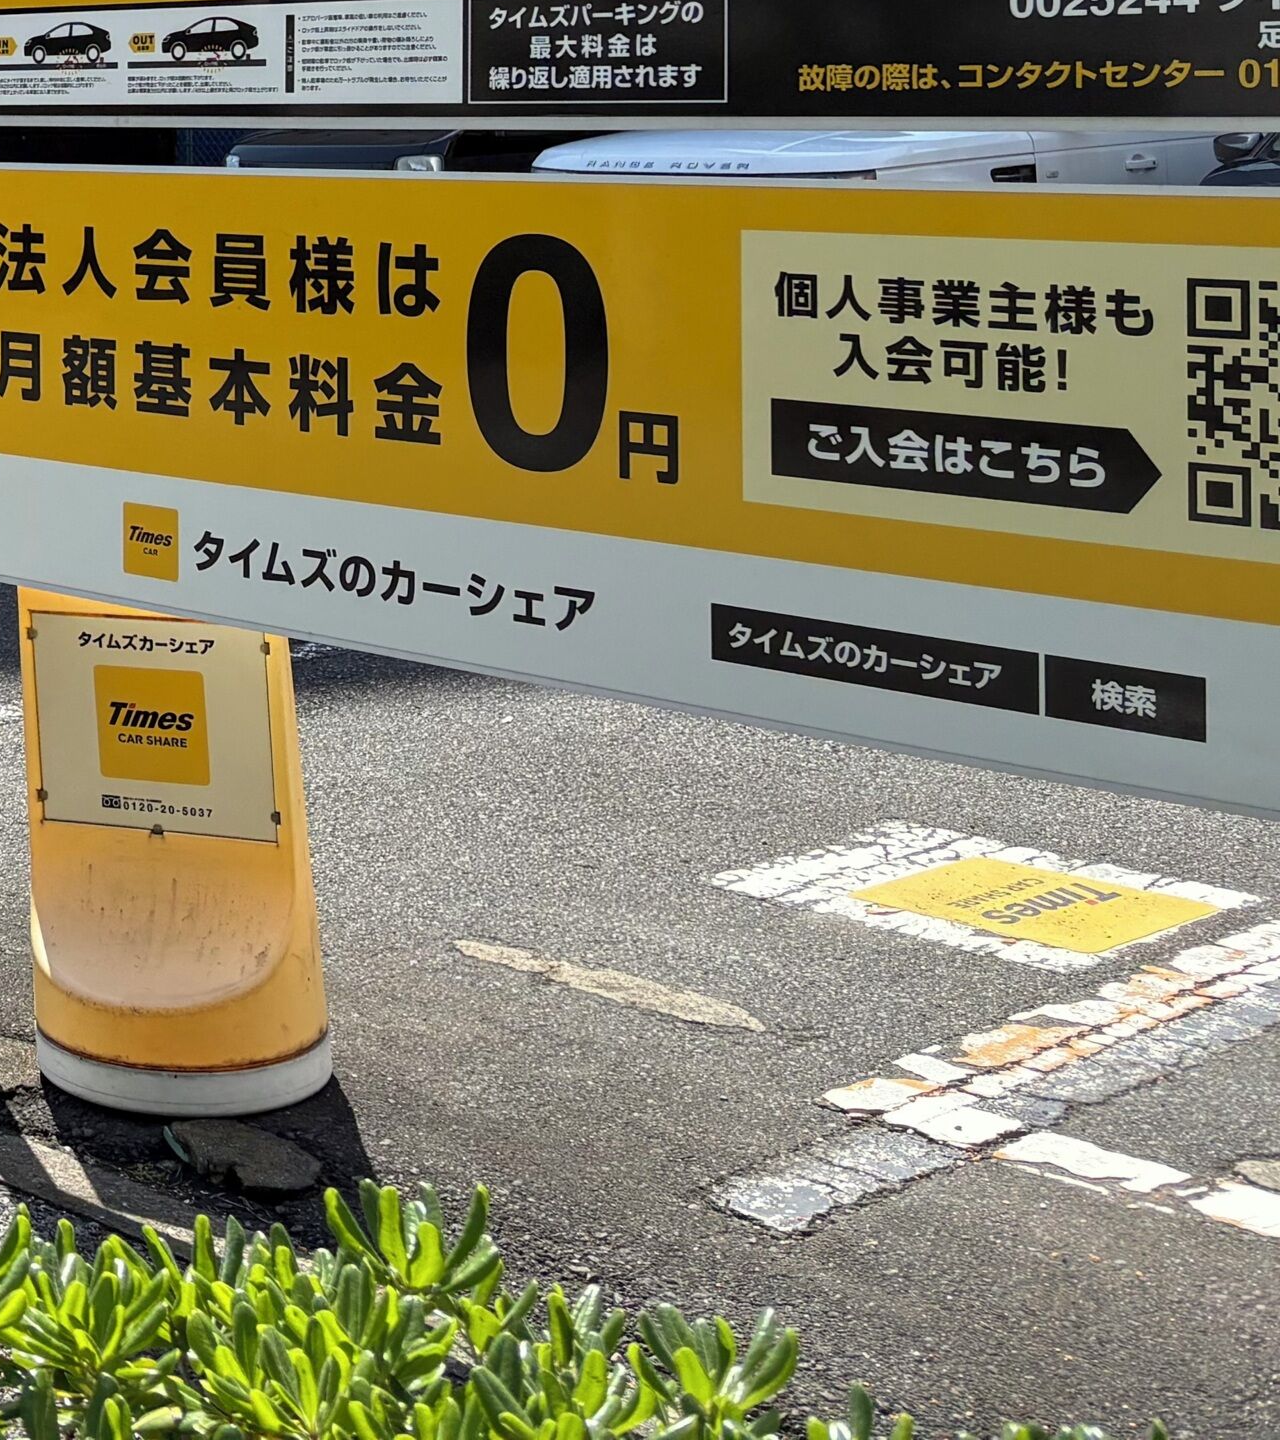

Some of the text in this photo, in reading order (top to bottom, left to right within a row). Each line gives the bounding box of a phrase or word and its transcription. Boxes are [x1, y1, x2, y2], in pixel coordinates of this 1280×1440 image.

[489, 0, 704, 30] タイムズパーキングの
[133, 35, 155, 45] OUT
[530, 33, 657, 60] 最大料金は
[489, 63, 702, 90] 繰り返し適用されます
[798, 59, 1224, 91] 故障の際は、コンタクトセンター
[774, 271, 1154, 337] 個人事業主様も
[466, 233, 679, 485] 0円
[833, 333, 1068, 393] 入会可能!
[807, 423, 1107, 488] ご入会はこちら
[127, 525, 173, 548] Times
[142, 547, 159, 557] CAR
[193, 531, 596, 631] タイムズのカーシェア
[78, 631, 215, 655] タイムズカーシェア
[728, 623, 1157, 718] タイムズのカーシェア 検索
[109, 701, 194, 732] Times
[118, 733, 188, 748] CAR SHARE
[123, 801, 213, 818] 0120-20-5037
[981, 882, 1123, 925] Times
